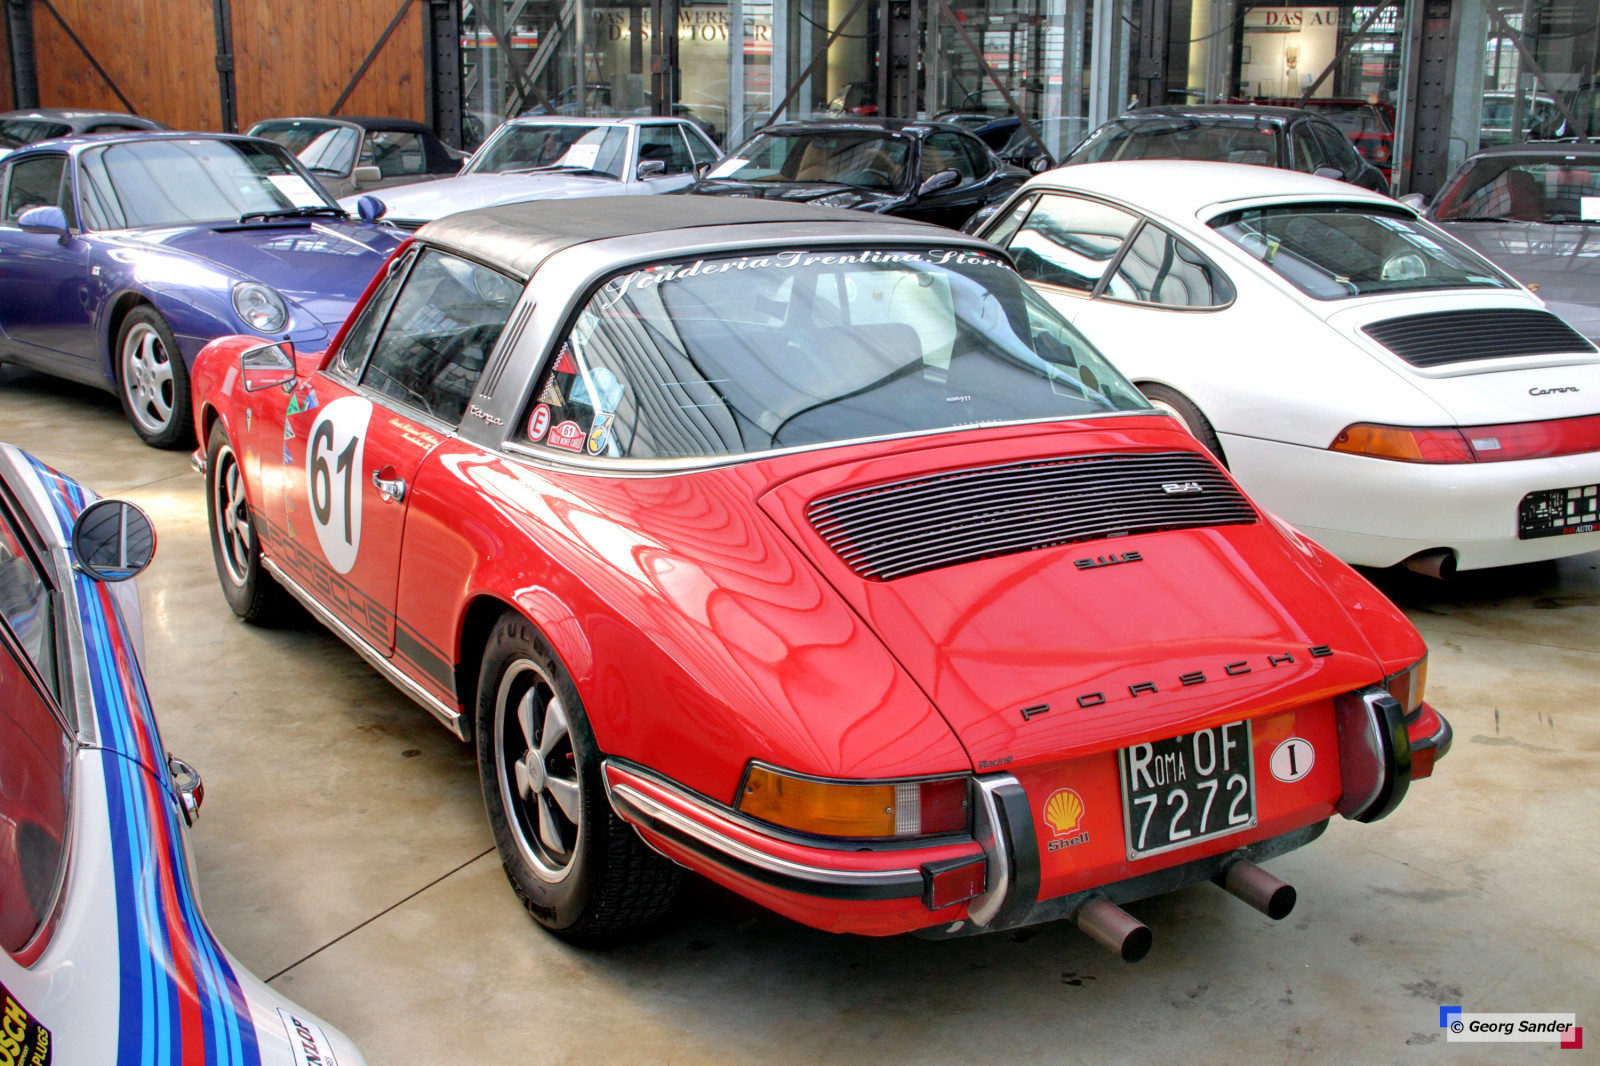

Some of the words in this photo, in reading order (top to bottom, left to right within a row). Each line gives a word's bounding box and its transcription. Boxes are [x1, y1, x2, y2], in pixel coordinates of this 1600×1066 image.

[1265, 10, 1302, 26] DAS
[602, 257, 771, 310] Scuderia
[776, 250, 923, 268] Trentina
[1529, 386, 1580, 396] Carrera
[533, 412, 545, 433] E
[564, 426, 573, 436] 61
[311, 419, 359, 546] 61
[269, 524, 390, 642] PORSCHE
[1021, 644, 1333, 721] PORSCHE
[1286, 744, 1299, 775] I
[1134, 774, 1249, 849] 7272
[1048, 832, 1089, 851] Shell
[0, 996, 27, 1066] OSCH
